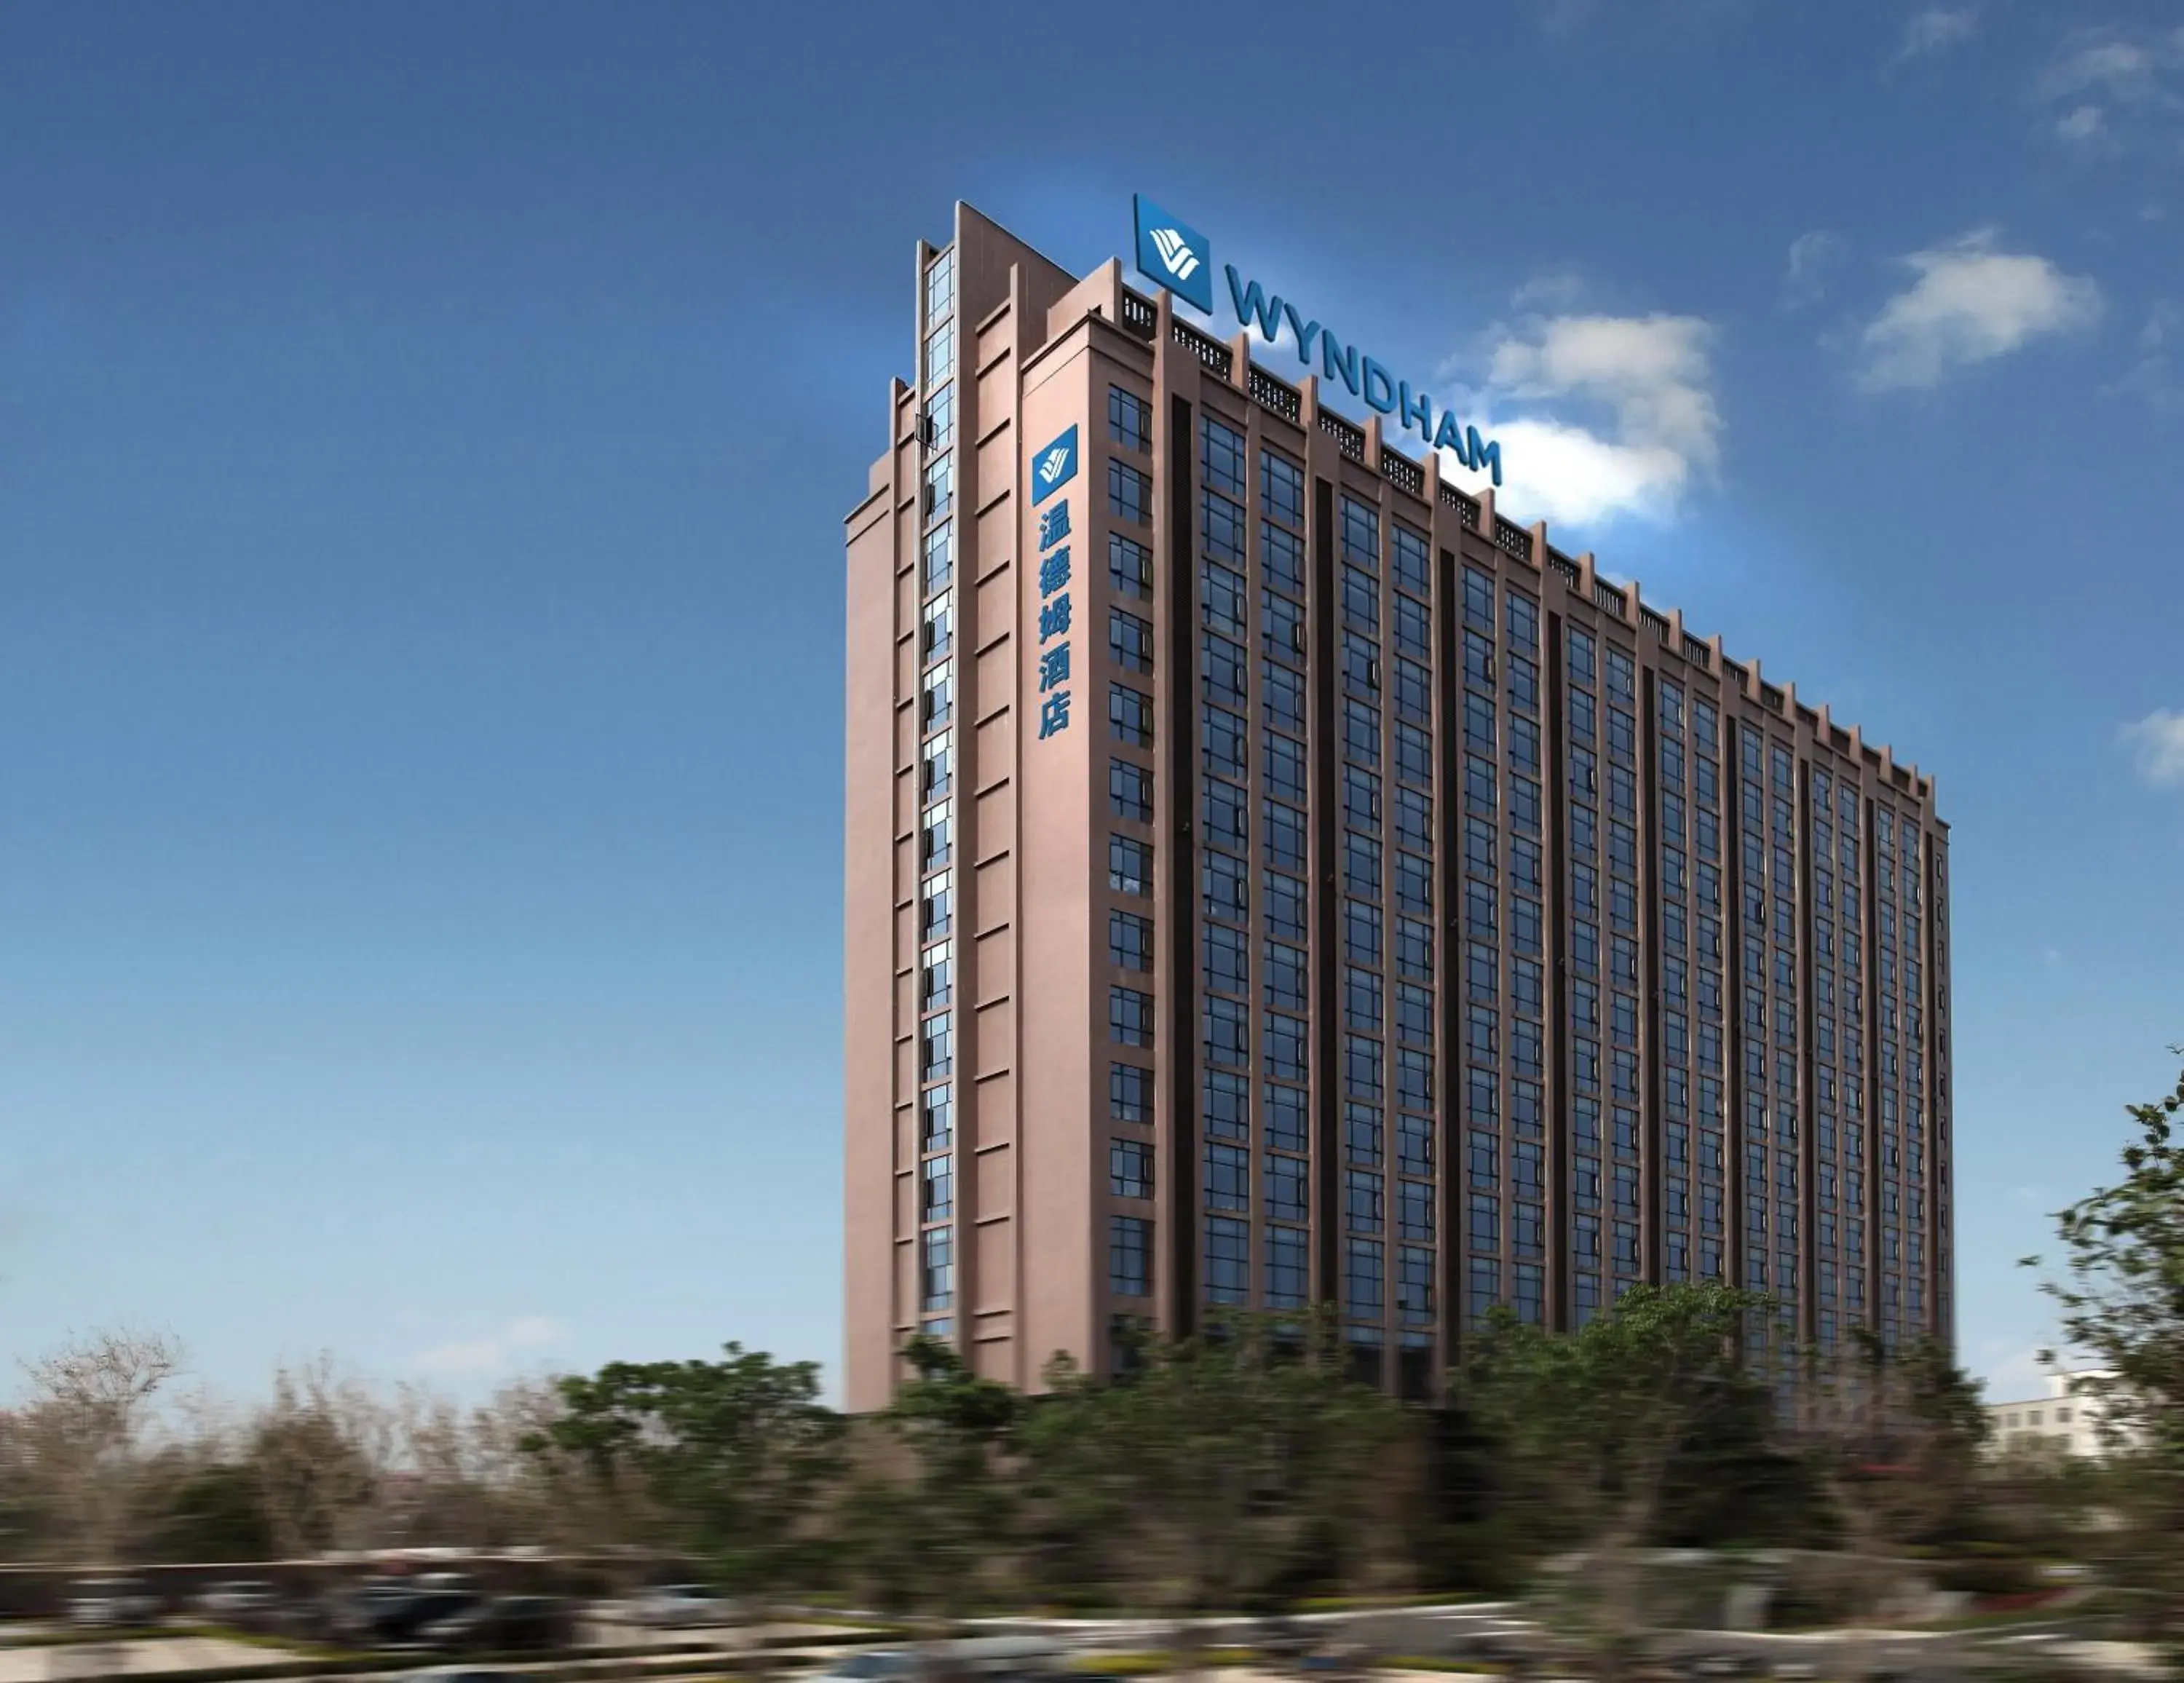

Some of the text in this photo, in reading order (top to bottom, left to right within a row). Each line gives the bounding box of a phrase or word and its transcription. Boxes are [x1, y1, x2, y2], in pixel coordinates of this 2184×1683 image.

[1224, 264, 1503, 487] WYNDHAM
[1038, 499, 1072, 740] 温德姆酒店
